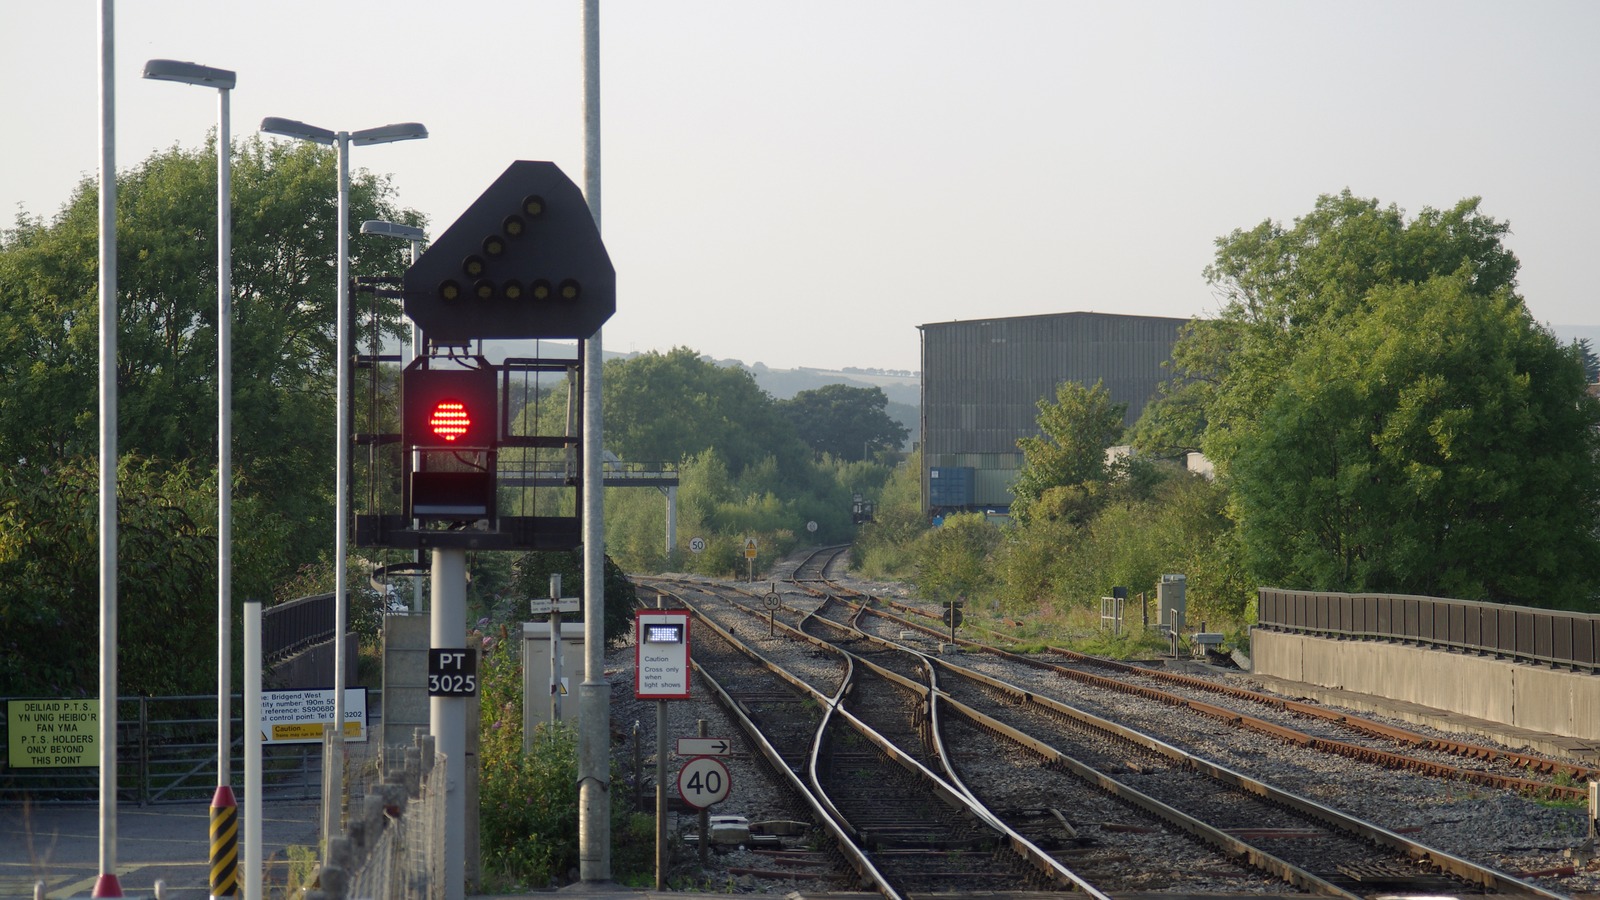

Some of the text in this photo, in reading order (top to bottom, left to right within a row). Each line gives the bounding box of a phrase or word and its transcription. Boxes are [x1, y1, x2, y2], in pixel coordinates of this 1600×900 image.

[692, 541, 703, 550] 50
[767, 597, 778, 606] 30
[440, 653, 465, 670] PT
[428, 675, 475, 692] 3025
[271, 694, 301, 702] Bridgend
[64, 703, 91, 711] P.T.S.
[21, 736, 49, 744] P.T.S.
[687, 770, 721, 795] 40
